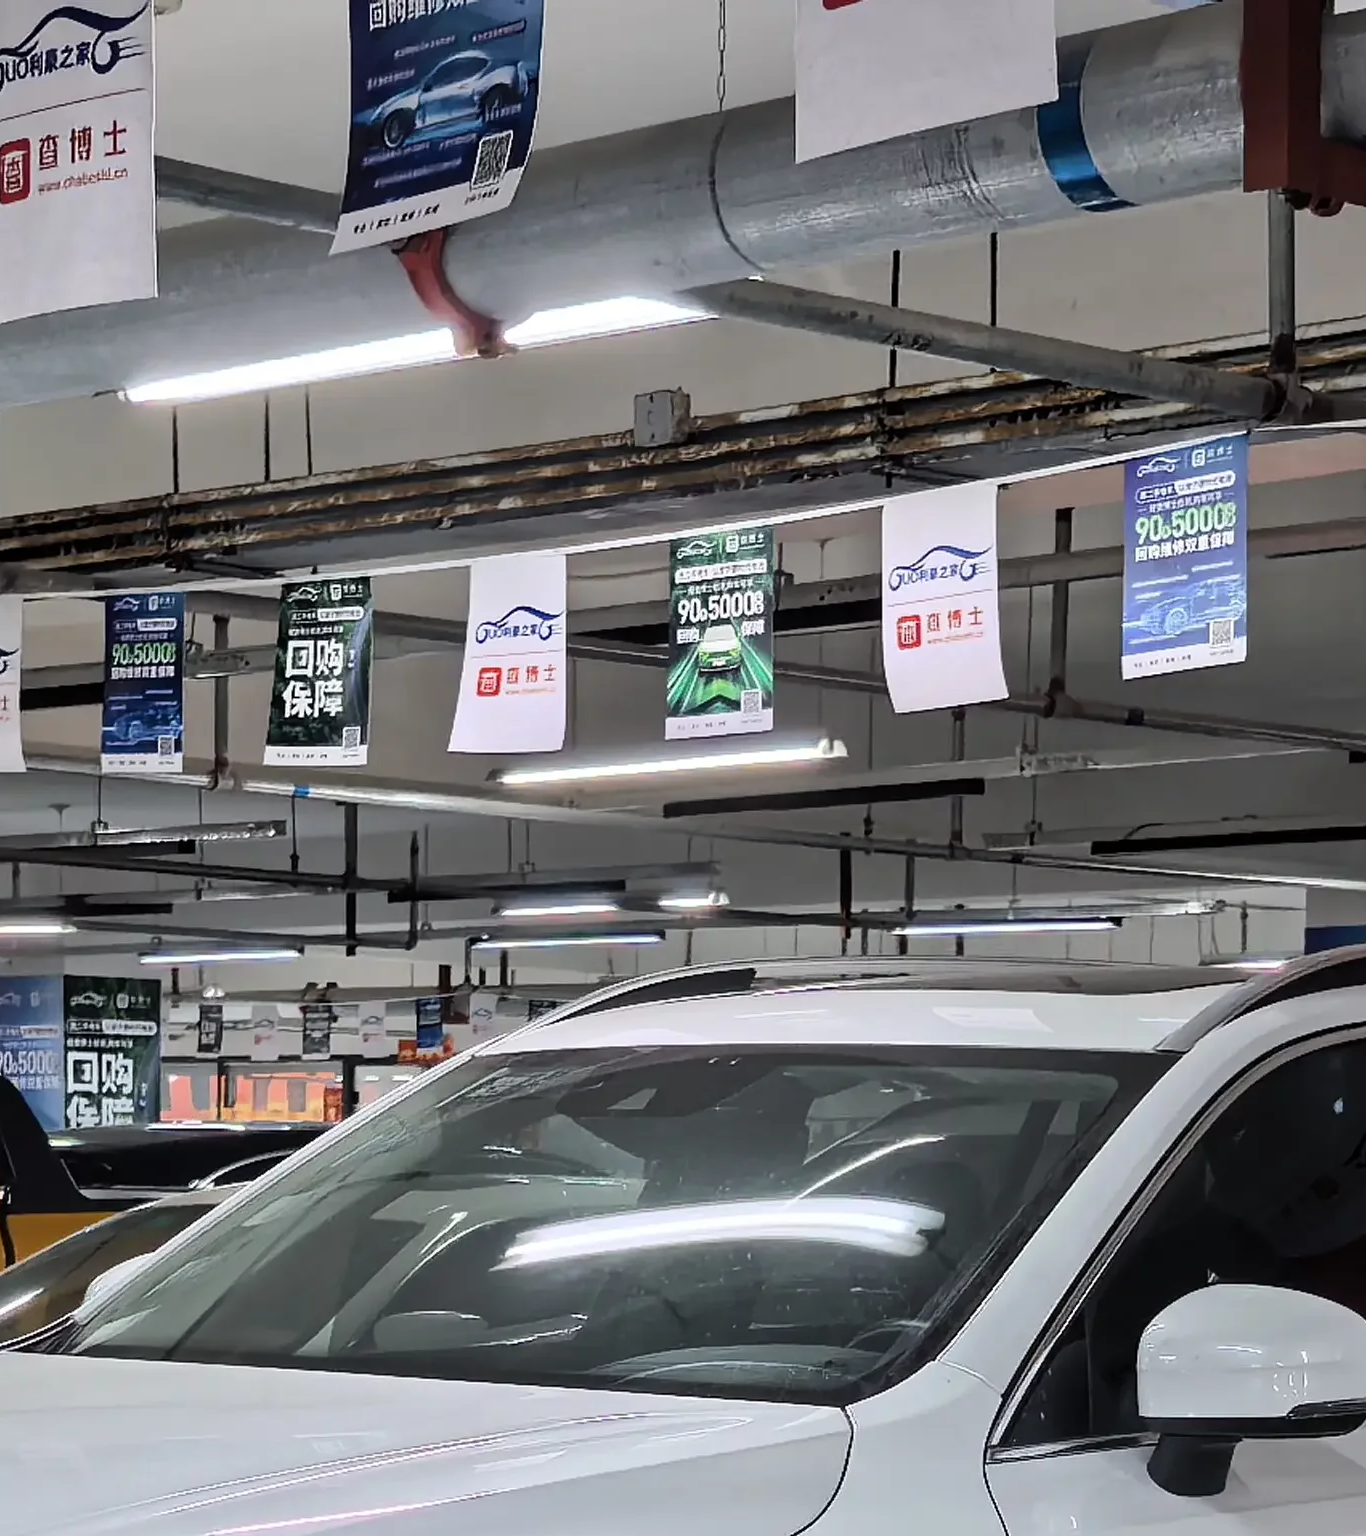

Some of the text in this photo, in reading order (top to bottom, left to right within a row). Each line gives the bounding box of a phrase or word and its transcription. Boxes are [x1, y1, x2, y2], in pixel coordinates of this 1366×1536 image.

[285, 638, 344, 678] 回购
[282, 679, 344, 719] 保障
[67, 1049, 134, 1095] 回购
